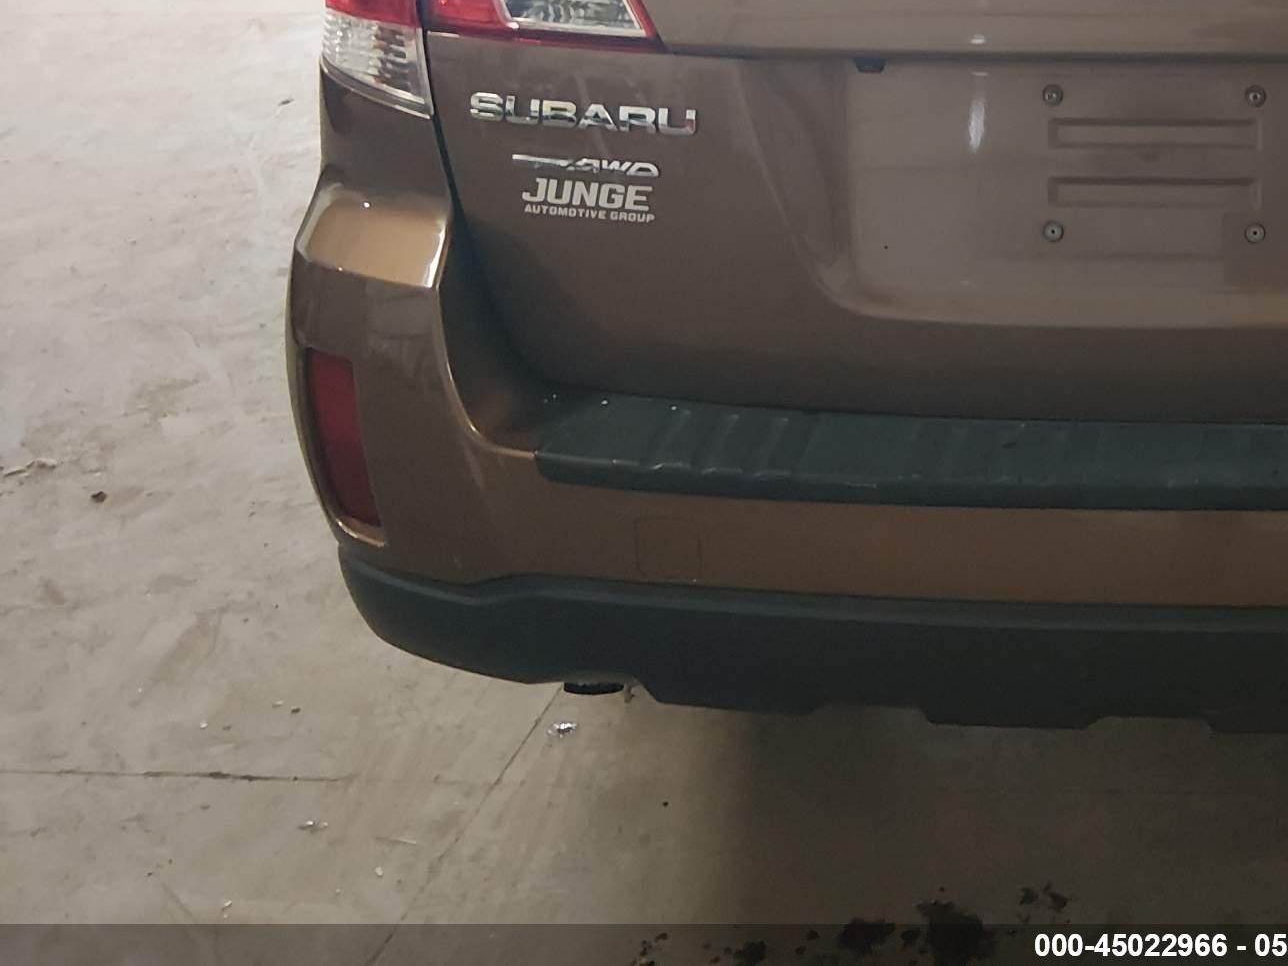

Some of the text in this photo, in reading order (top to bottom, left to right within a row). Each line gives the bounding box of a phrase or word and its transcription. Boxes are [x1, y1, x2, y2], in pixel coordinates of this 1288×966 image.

[469, 91, 697, 136] SUBARU
[522, 177, 653, 211] JUNGE
[524, 203, 656, 223] AUTOMOTIVE GROUP
